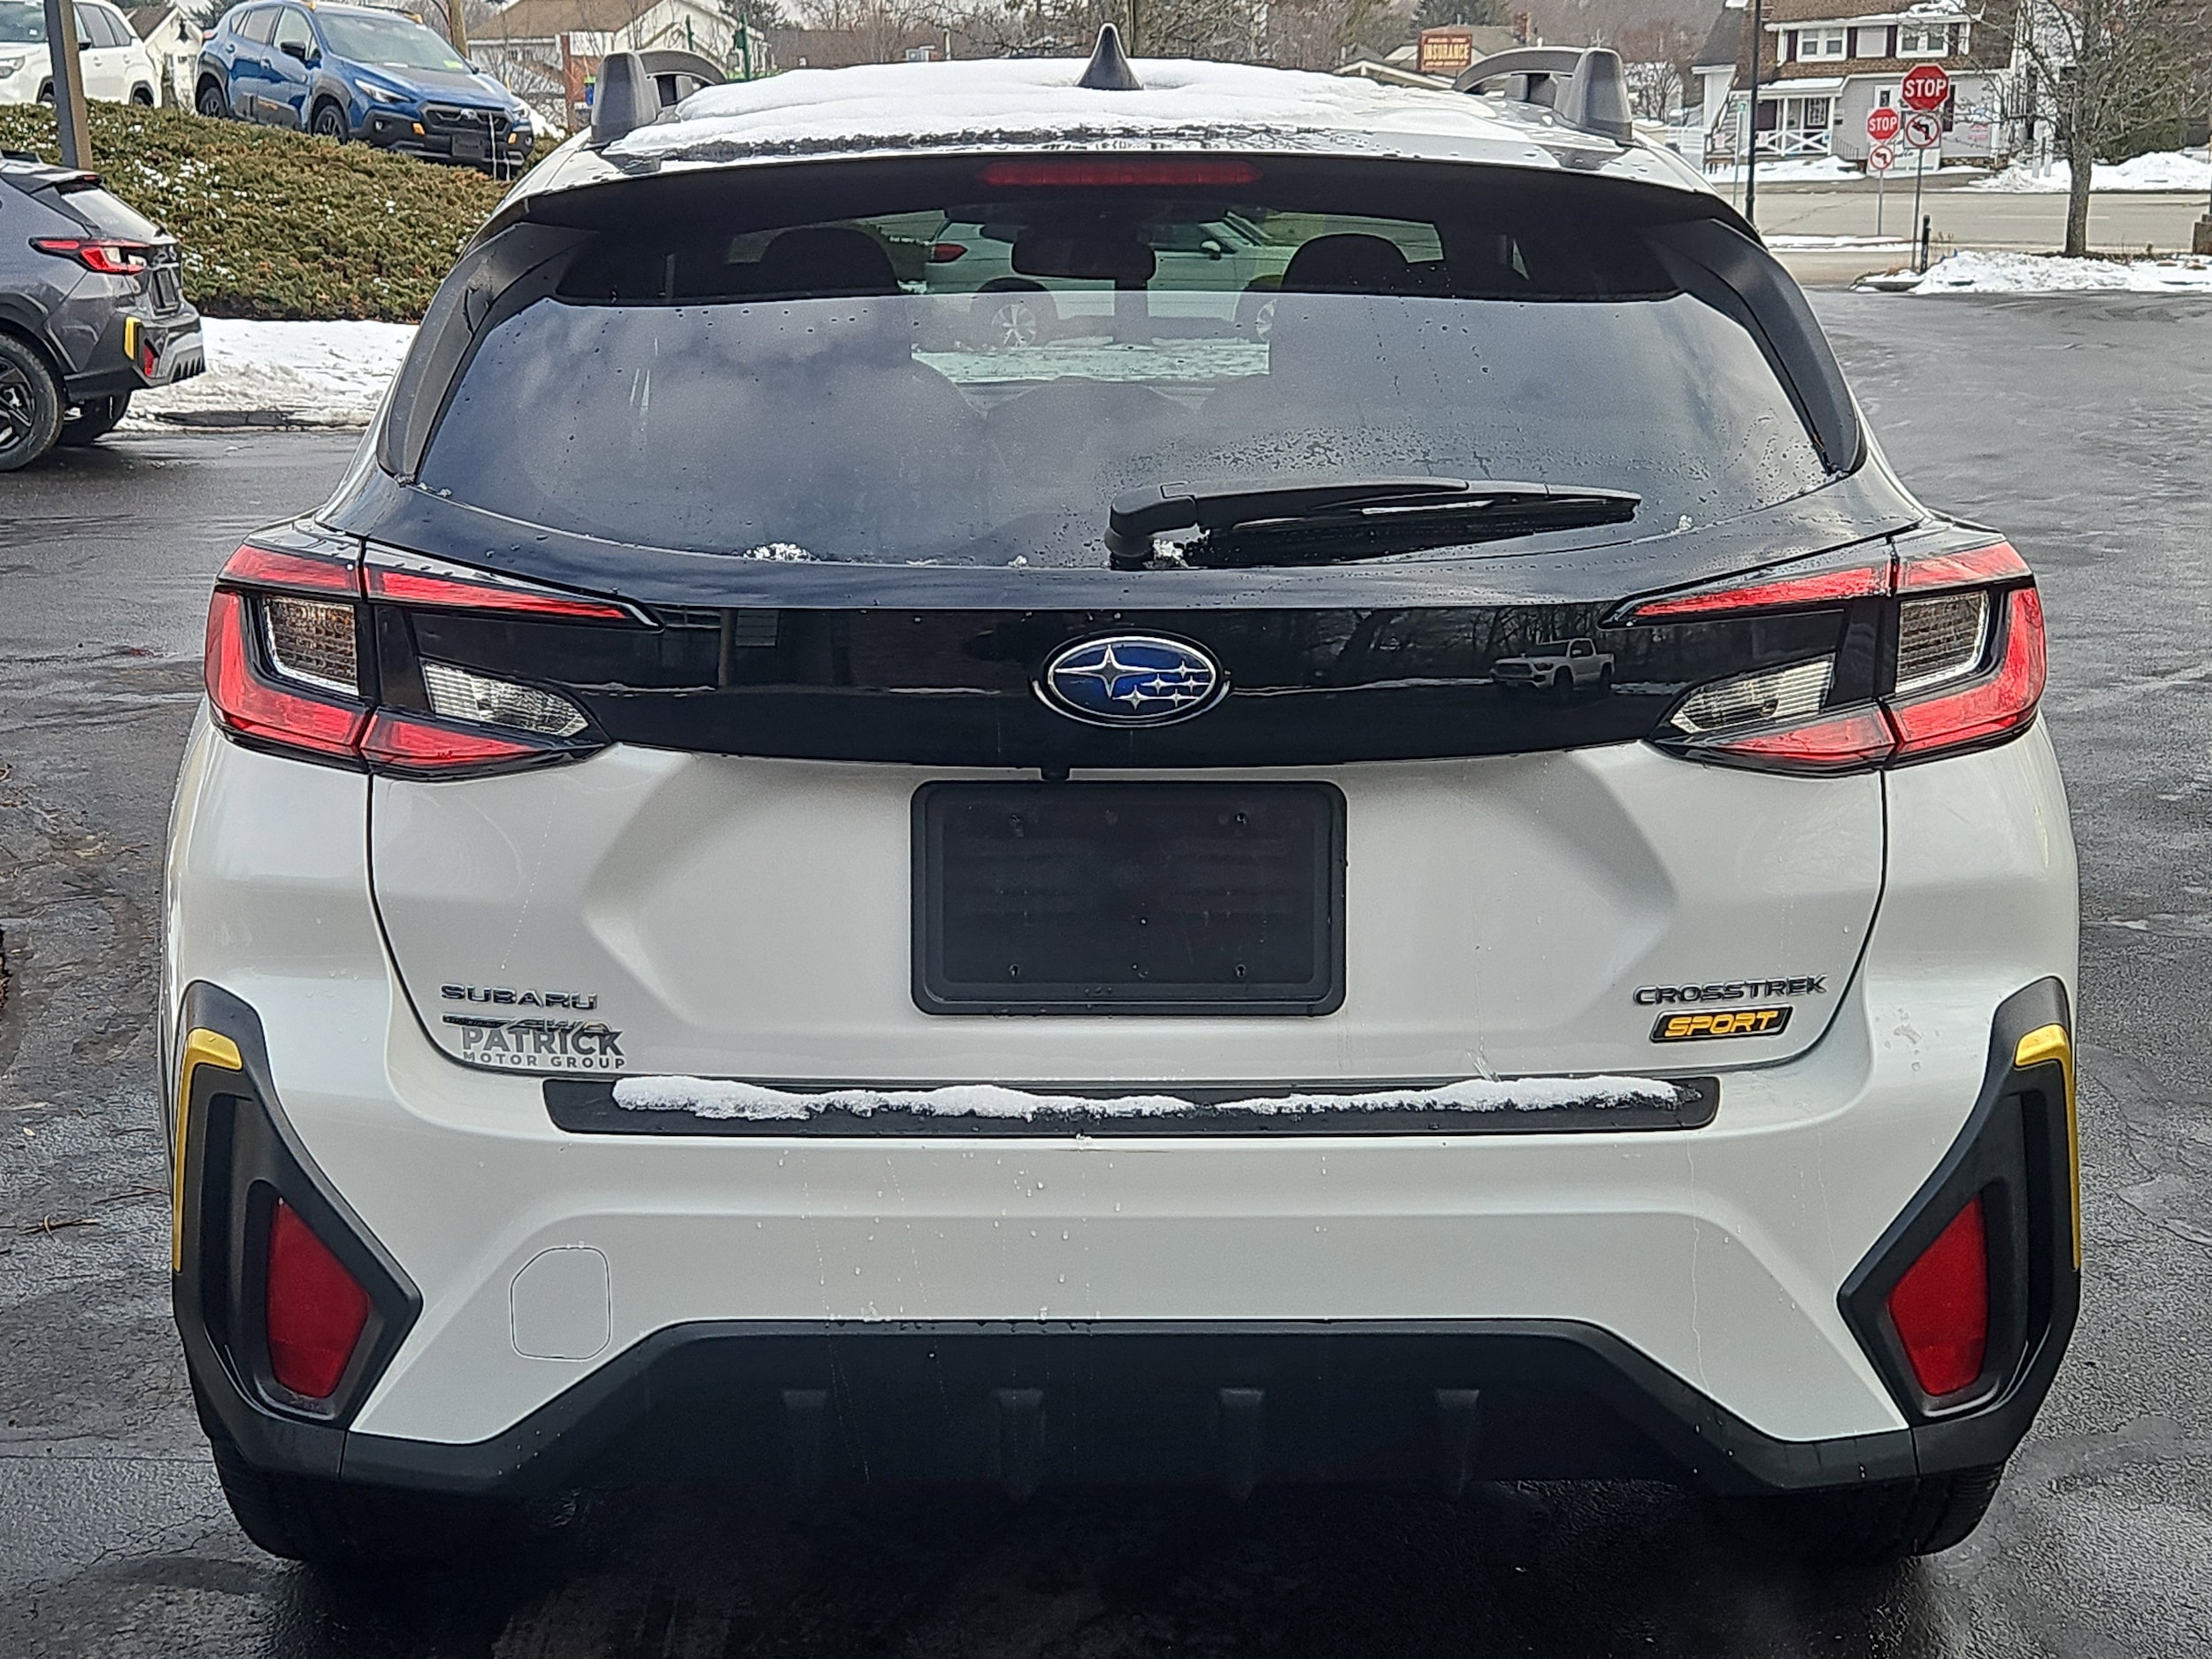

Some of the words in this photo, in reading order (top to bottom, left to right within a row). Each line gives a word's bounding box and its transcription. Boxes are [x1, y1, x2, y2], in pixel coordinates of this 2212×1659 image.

[1423, 43, 1470, 60] INSURANCE
[1904, 79, 1947, 97] STOP
[1869, 117, 1898, 128] STOP
[441, 983, 597, 1010] SUBARU
[1634, 974, 1827, 1005] CROSSTREK
[1664, 1010, 1778, 1037] SPORT
[461, 1025, 625, 1056] PATRICK
[463, 1051, 538, 1066] MOTOR
[549, 1056, 626, 1069] GROUP
